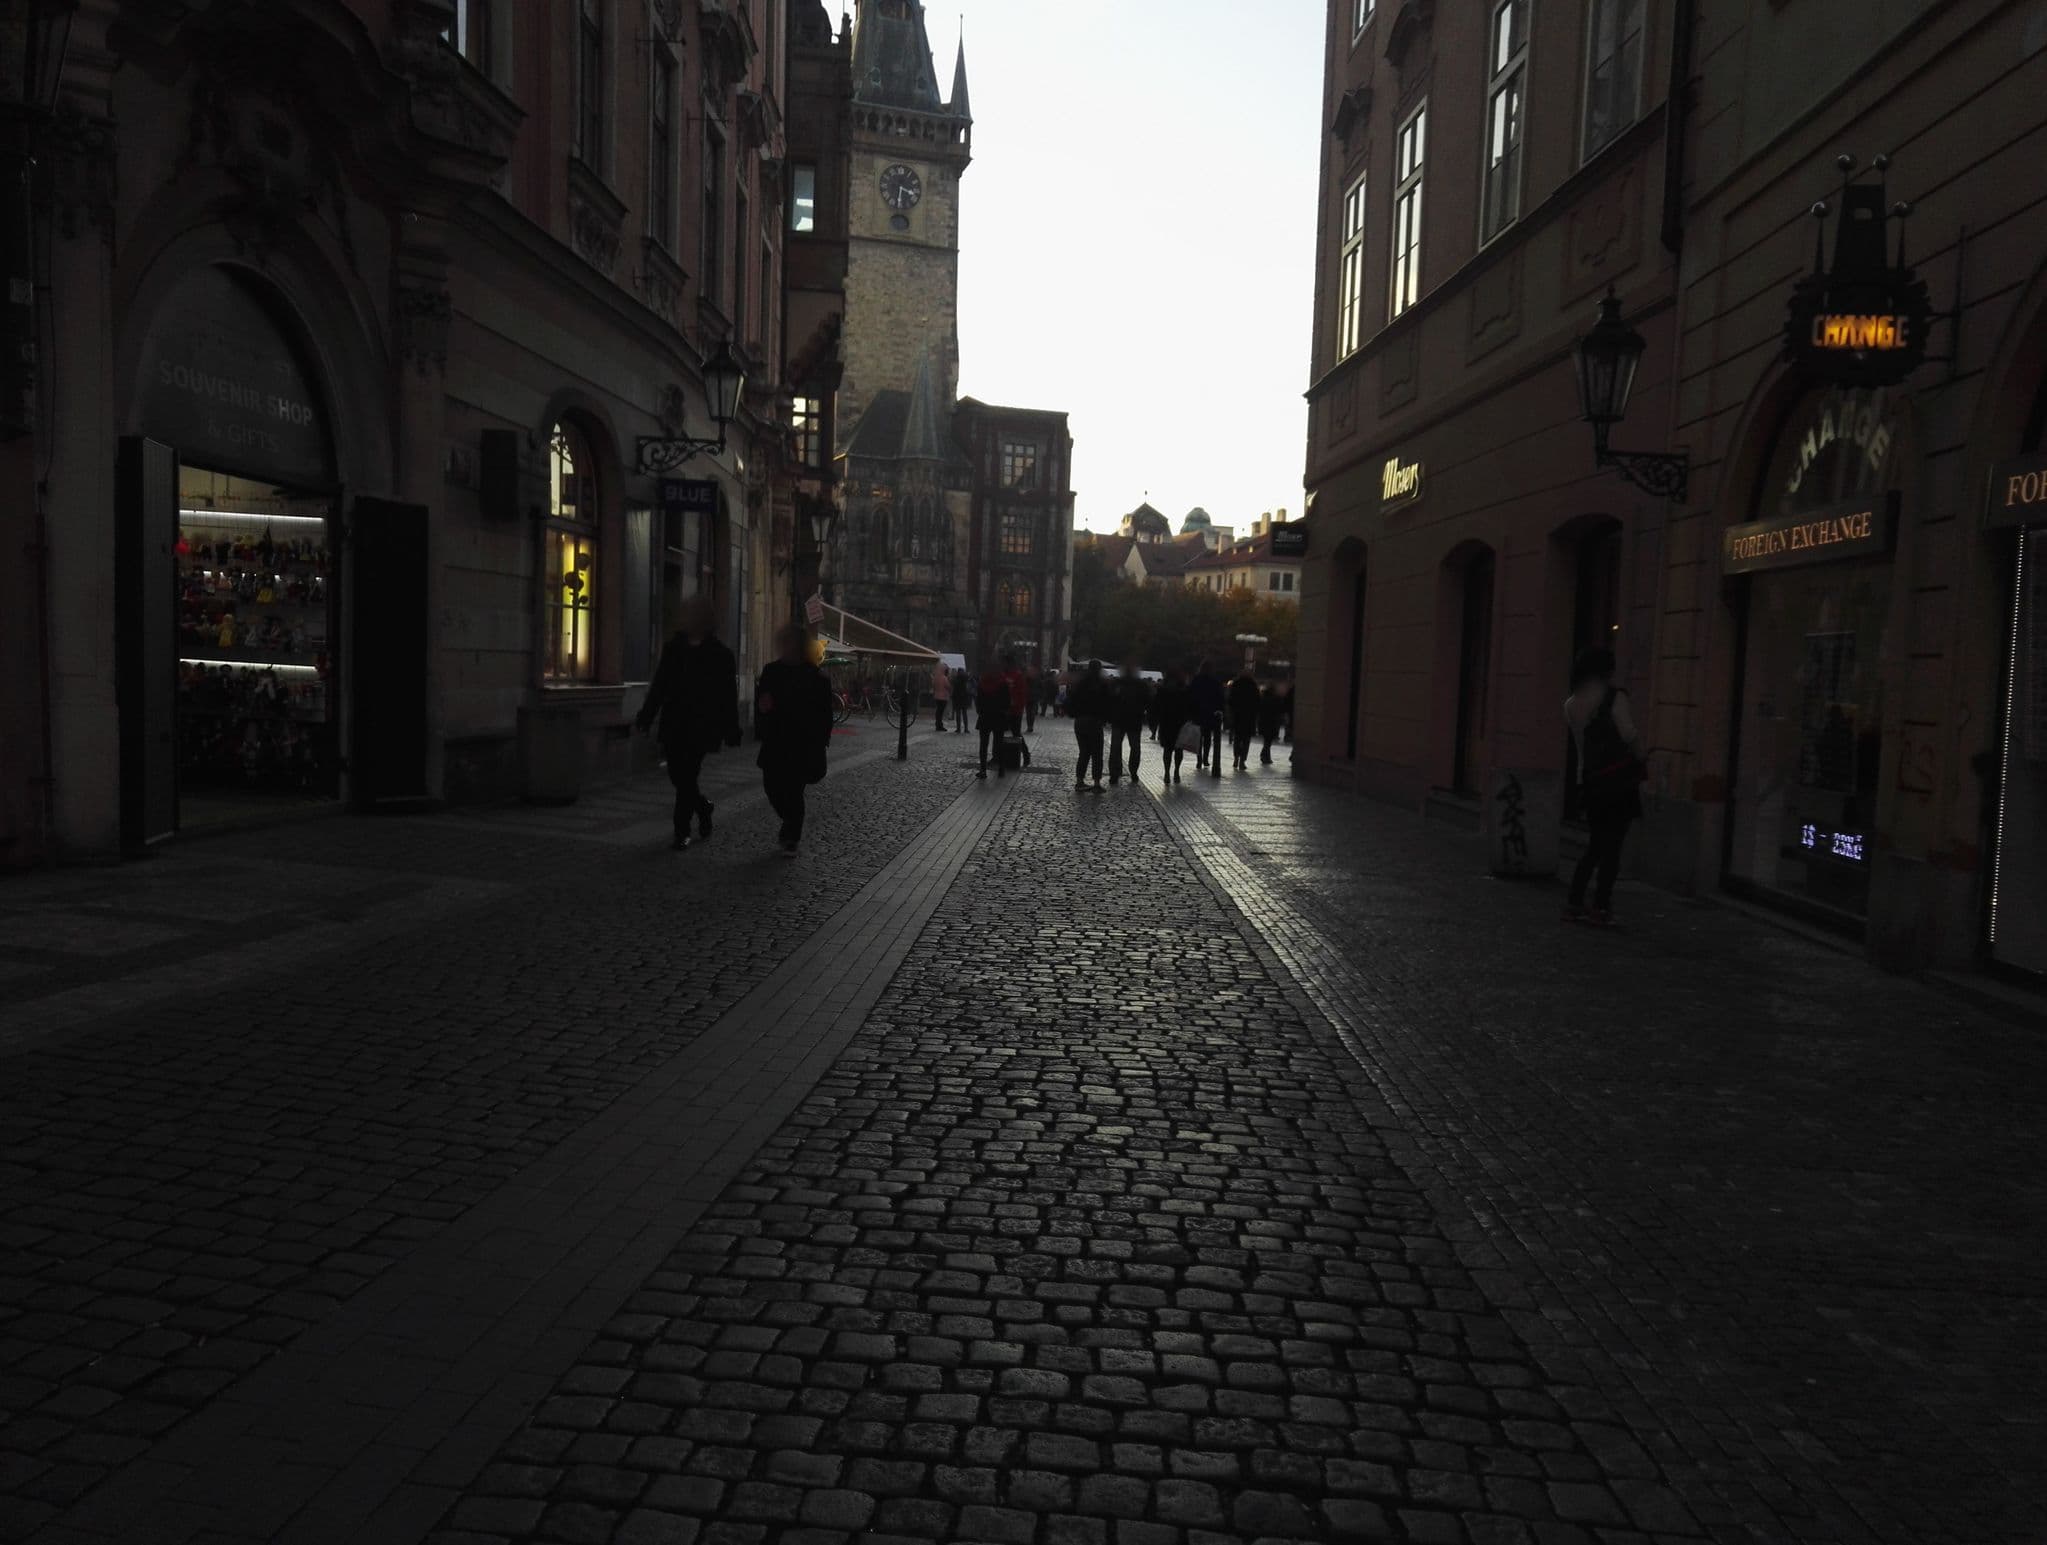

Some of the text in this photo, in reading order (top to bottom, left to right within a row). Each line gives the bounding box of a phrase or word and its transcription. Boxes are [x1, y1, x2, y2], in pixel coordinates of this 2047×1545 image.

[1811, 313, 1910, 350] CHANGE
[159, 360, 314, 427] SOUVENIR SHOP
[664, 486, 713, 504] BLUE
[1732, 511, 1873, 561] FOREIGN EXCHANGE
